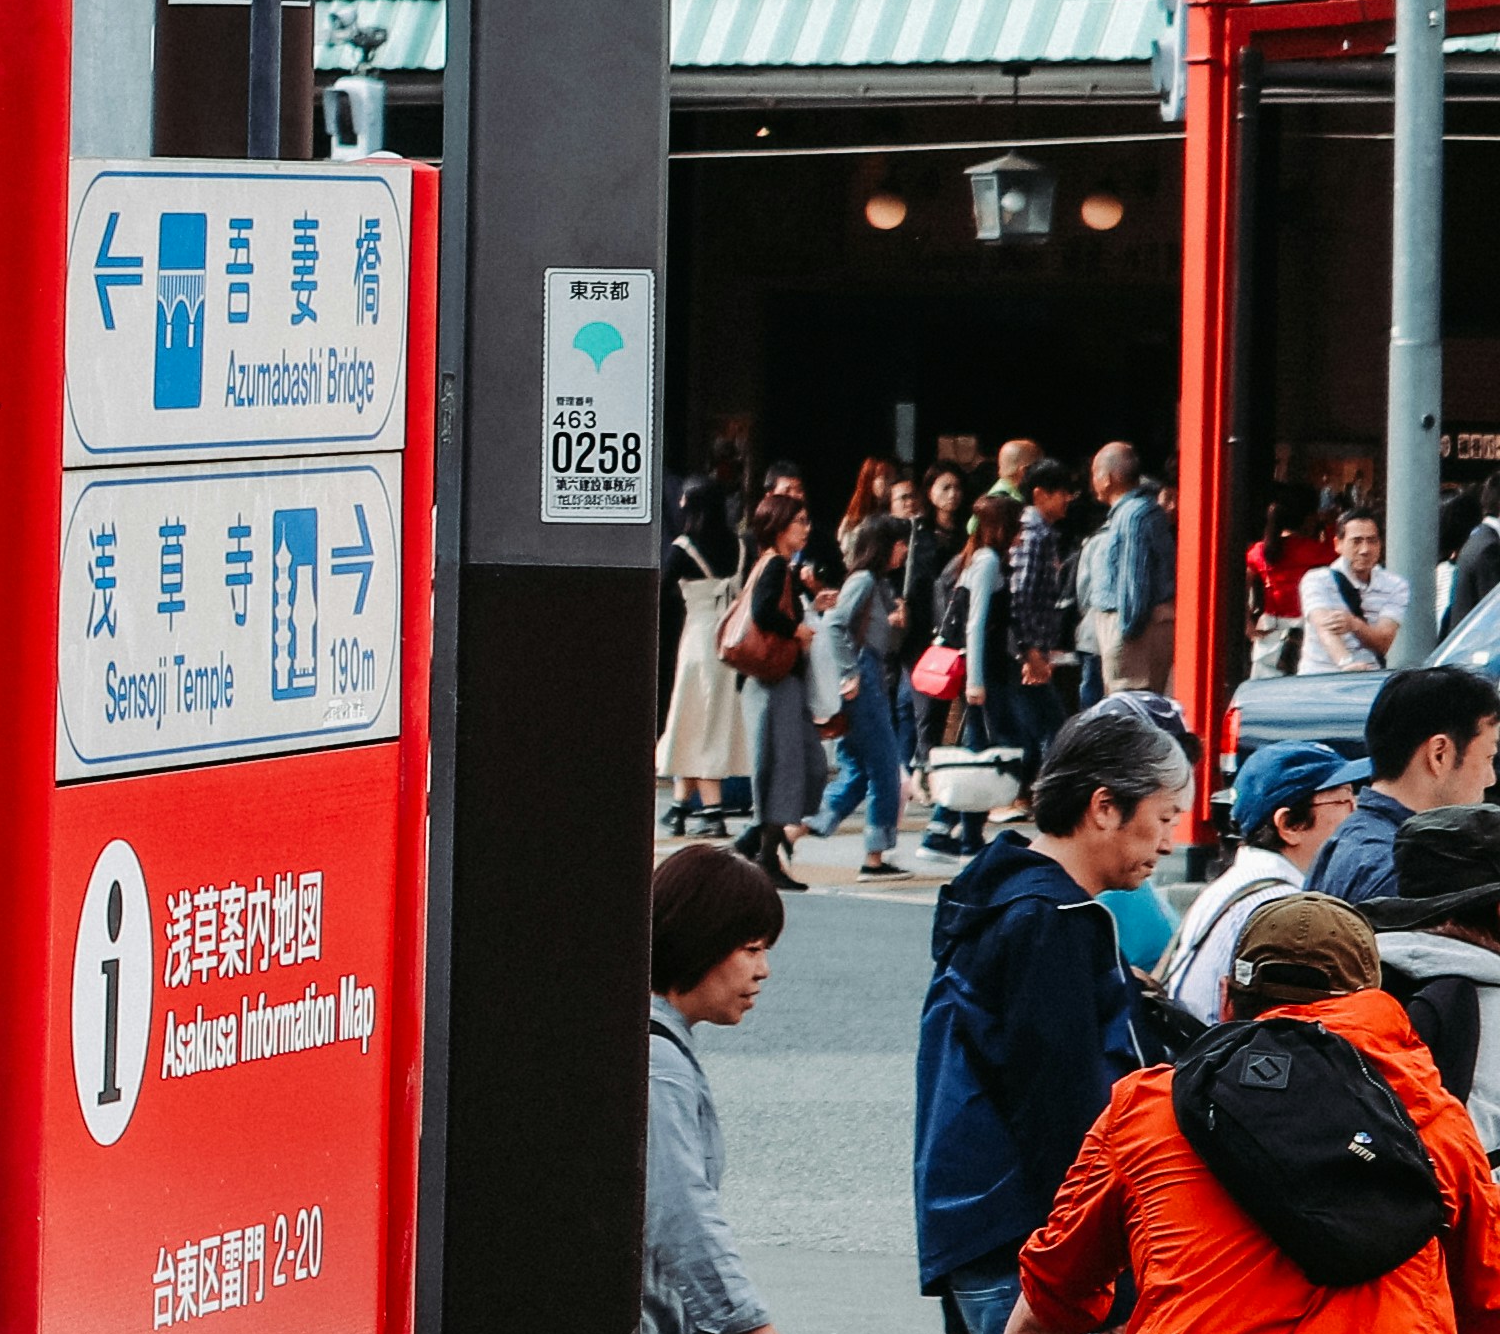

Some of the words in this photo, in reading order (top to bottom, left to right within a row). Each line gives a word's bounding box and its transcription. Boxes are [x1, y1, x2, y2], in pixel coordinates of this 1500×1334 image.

[226, 210, 381, 326] 吾妻橋
[569, 280, 630, 301] 東京都
[225, 347, 323, 408] Azumabashi
[327, 349, 375, 414] Bridge
[556, 396, 594, 407] 管理番号
[552, 410, 597, 429] 463
[552, 431, 642, 475] 0258
[86, 512, 253, 639] 浅草寺
[105, 655, 167, 730] Sensoji
[174, 650, 234, 725] Temple
[330, 638, 377, 696] 190m
[164, 870, 324, 989] 浅草案内地図
[161, 1004, 237, 1080] Asakusa
[240, 982, 337, 1063] Information
[339, 973, 376, 1055] Map
[152, 1223, 266, 1331] 台東区雷門
[271, 1204, 324, 1288] 2-20
